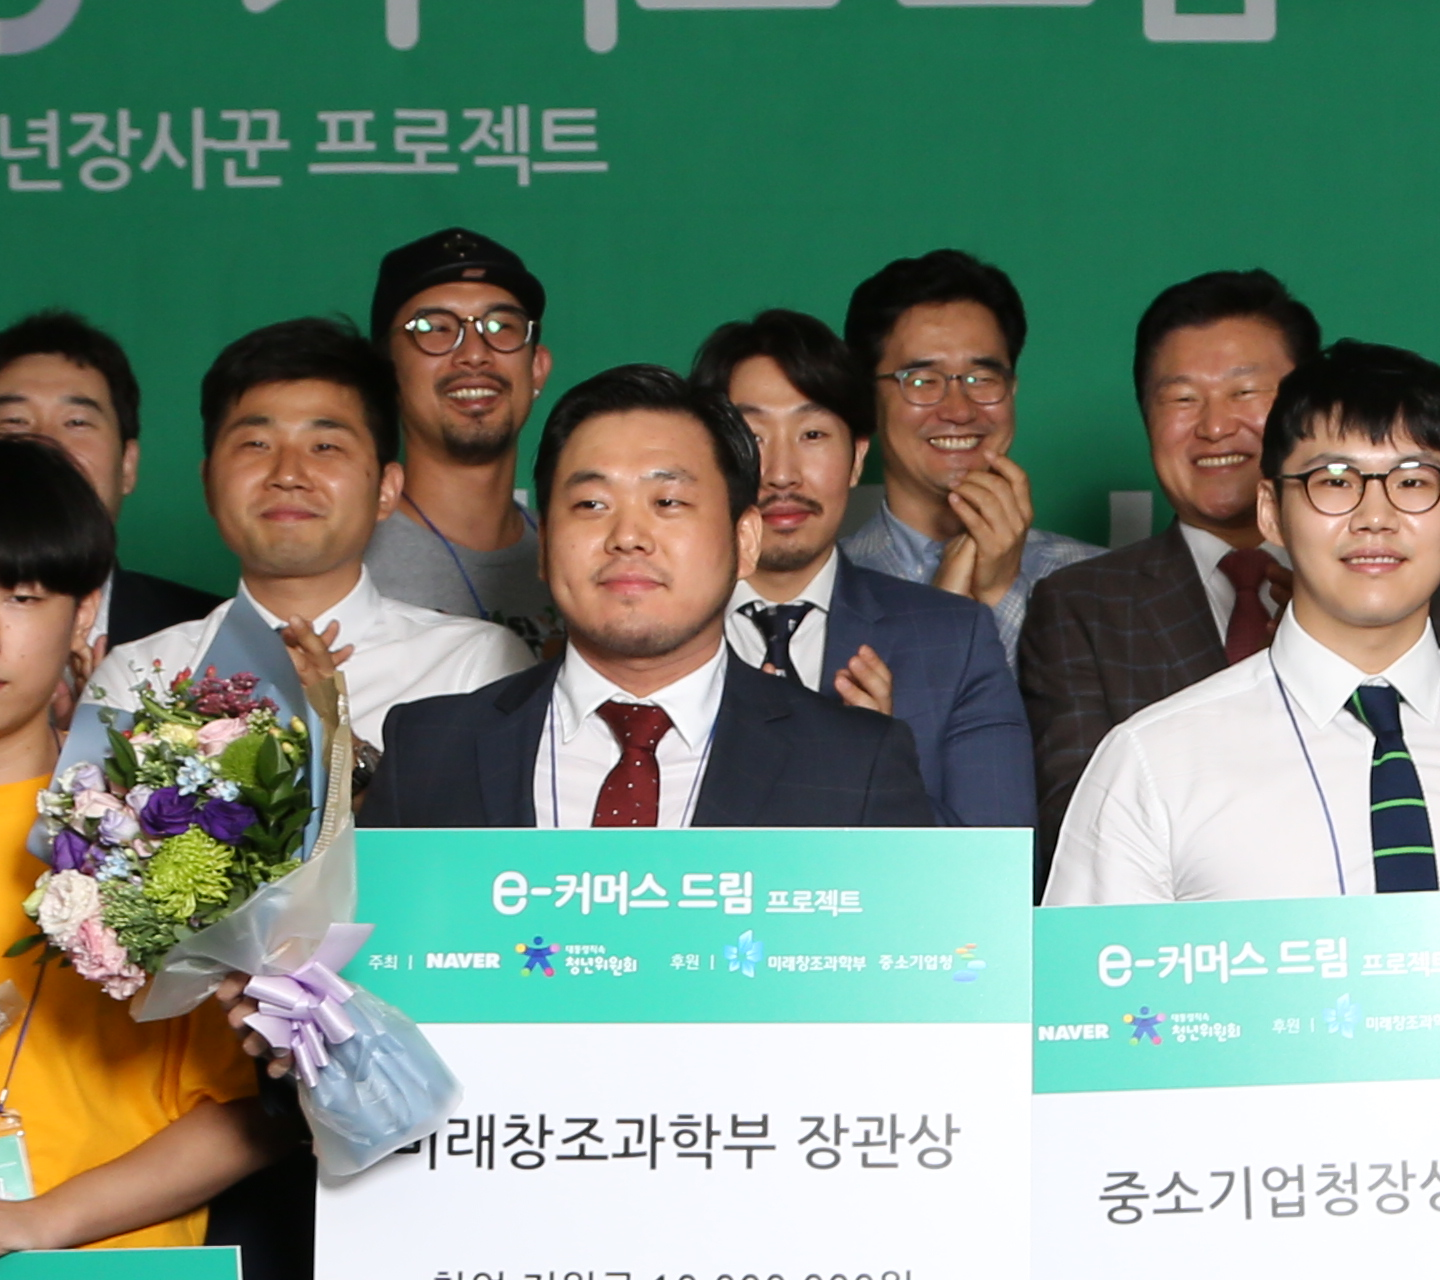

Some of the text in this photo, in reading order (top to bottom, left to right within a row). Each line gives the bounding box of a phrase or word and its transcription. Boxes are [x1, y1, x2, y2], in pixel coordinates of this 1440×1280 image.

[307, 102, 610, 185] 프로젝트
[492, 870, 863, 917] e-커머스 드림 프로젝트
[368, 954, 398, 970] 주최
[426, 952, 500, 969] NAVER
[565, 956, 637, 977] 청년위원회
[670, 953, 700, 970] 후원
[767, 955, 867, 972] 미래창조과학부
[878, 954, 953, 971] 중소기업청
[1098, 940, 1269, 988] e-커머스
[1276, 936, 1349, 978] 드림
[1038, 1023, 1110, 1041] NAVER
[1171, 1023, 1241, 1043] 청년위원회
[1272, 1017, 1300, 1034] 후원
[797, 1112, 961, 1170] 장관상
